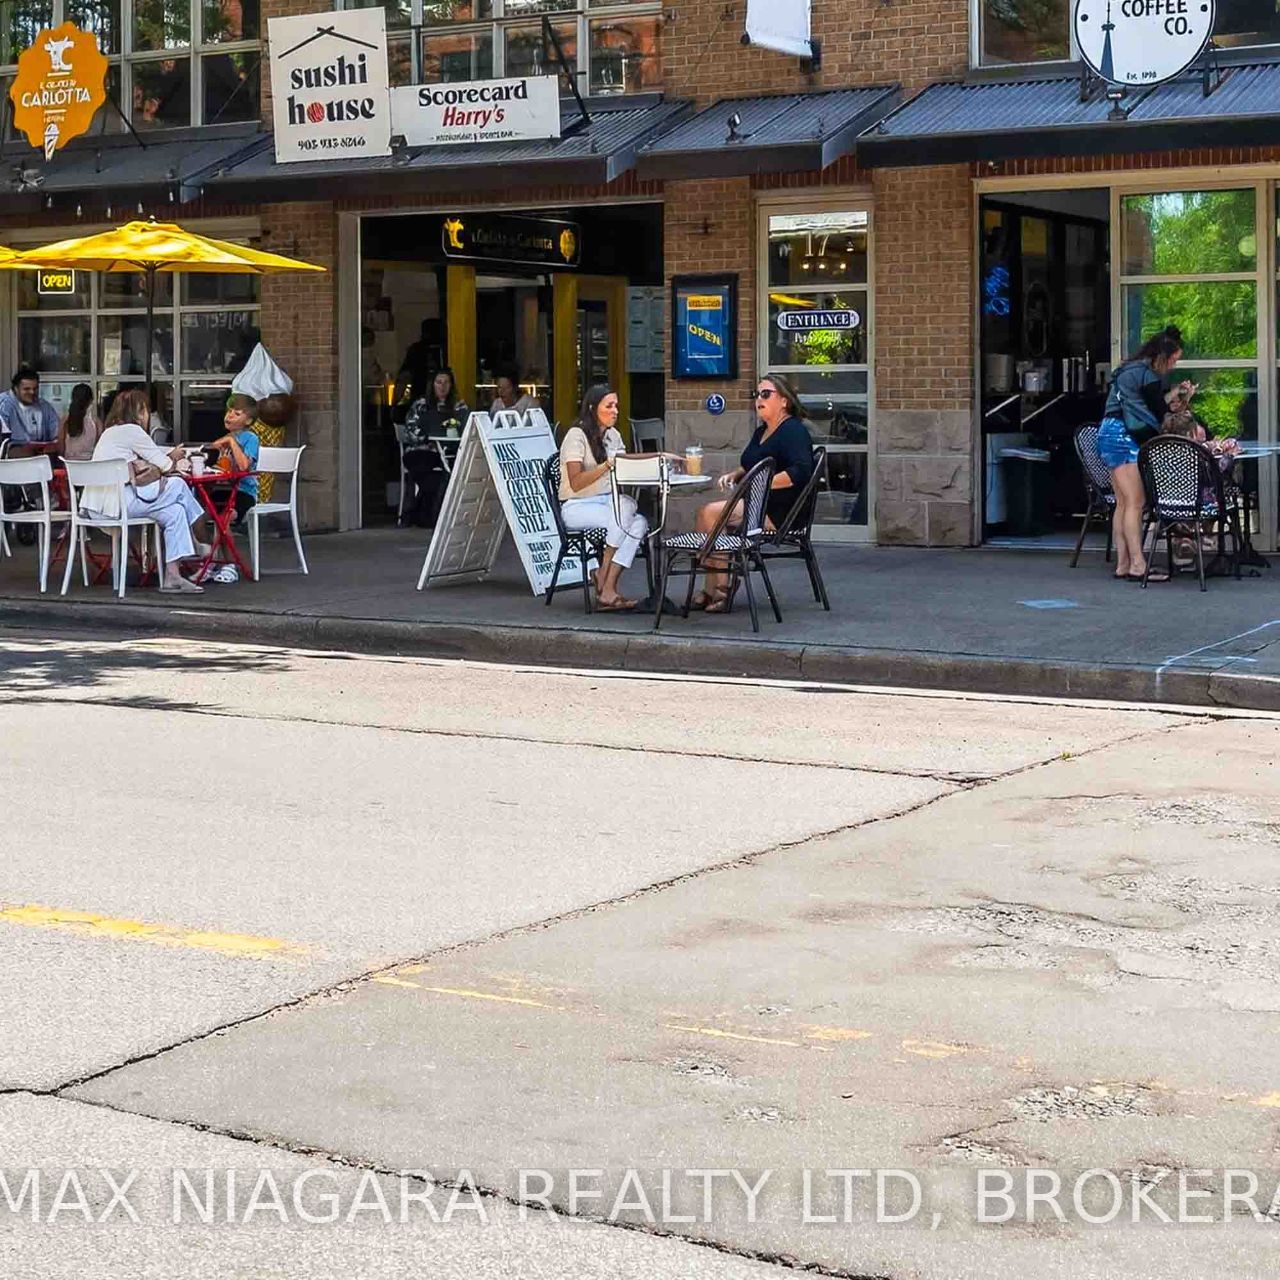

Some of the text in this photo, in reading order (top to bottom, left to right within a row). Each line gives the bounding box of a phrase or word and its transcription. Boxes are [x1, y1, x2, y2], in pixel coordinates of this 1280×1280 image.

[1164, 17, 1193, 36] CO.
[290, 53, 368, 90] sushi
[22, 88, 91, 107] CARLOTTA
[419, 80, 528, 106] Scorecard
[287, 95, 376, 126] house
[442, 104, 505, 129] Harry's
[42, 274, 72, 288] OPEN
[787, 313, 849, 327] ENTRANCE
[688, 323, 721, 346] OPEN
